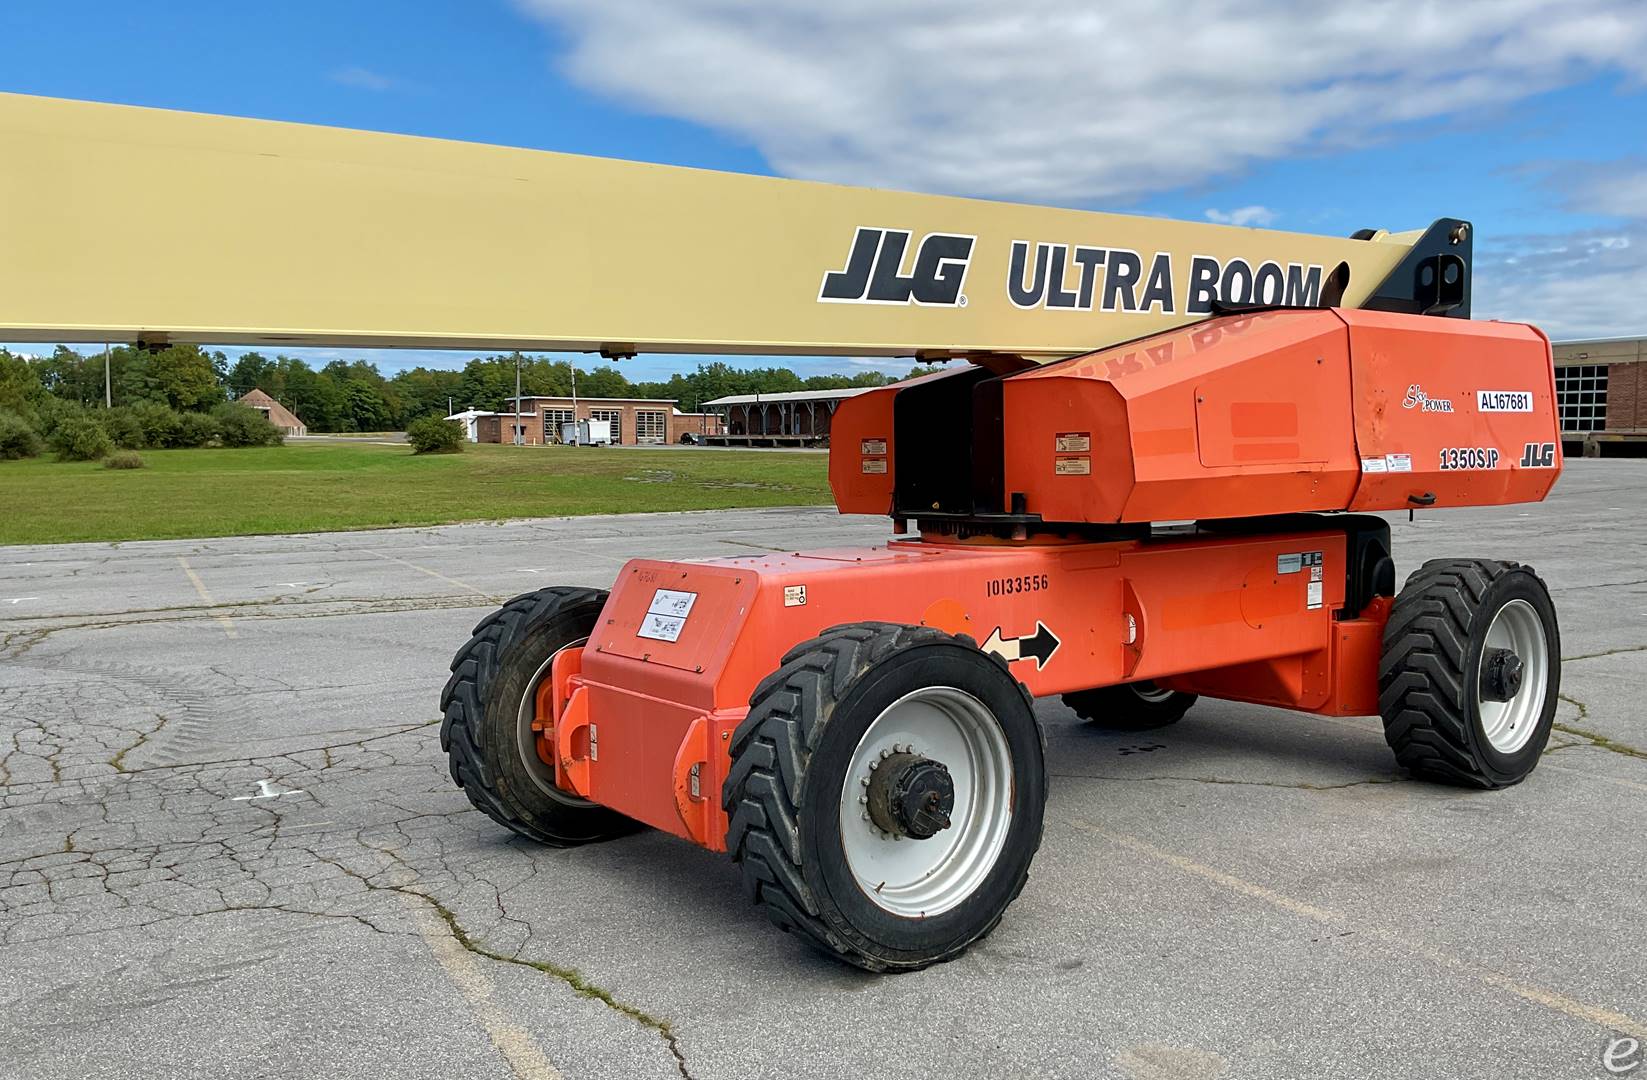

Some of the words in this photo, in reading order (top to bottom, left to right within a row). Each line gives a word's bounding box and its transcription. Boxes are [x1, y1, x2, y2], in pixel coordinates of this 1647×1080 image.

[1006, 240, 1175, 314] ULTRA
[1185, 254, 1323, 316] BOOM
[1481, 393, 1529, 411] AL167681
[1440, 448, 1499, 471] 1350SJP
[1519, 442, 1556, 468] JLG
[986, 573, 1049, 598] 10133556
